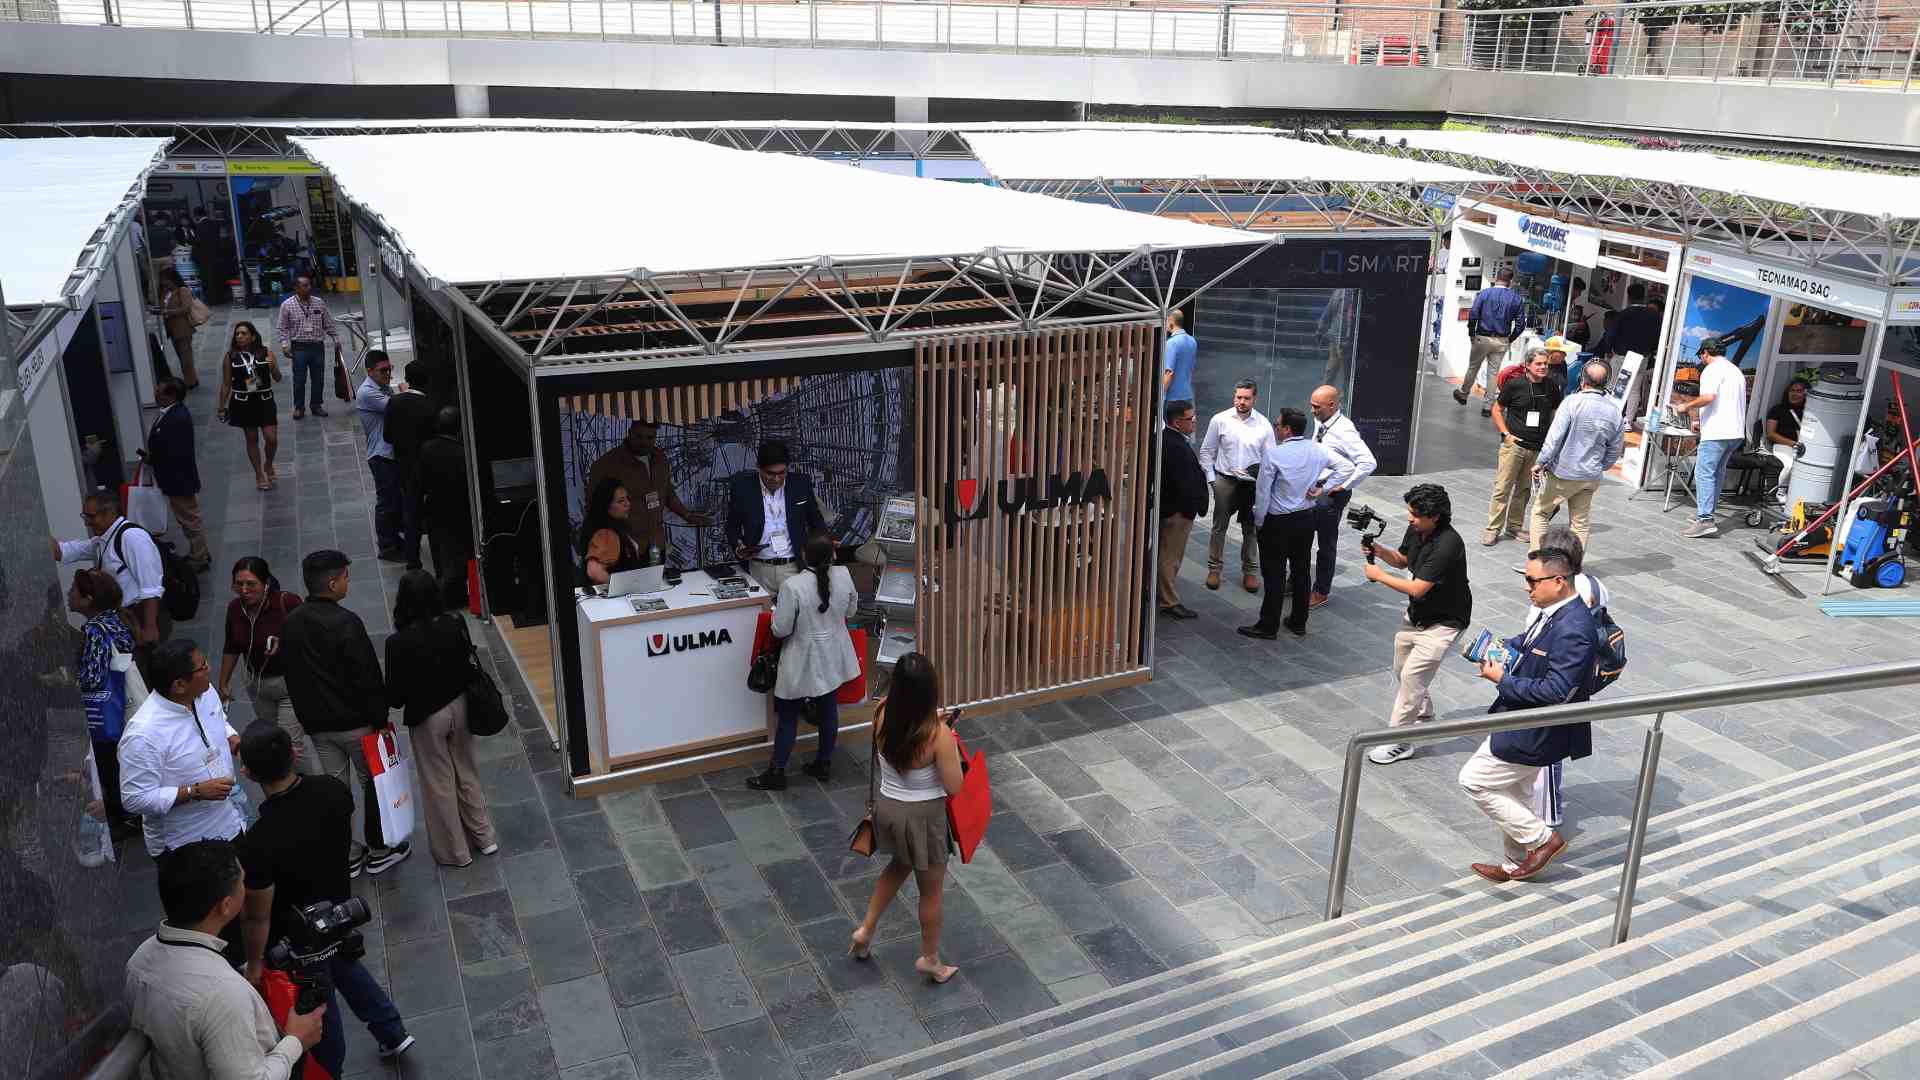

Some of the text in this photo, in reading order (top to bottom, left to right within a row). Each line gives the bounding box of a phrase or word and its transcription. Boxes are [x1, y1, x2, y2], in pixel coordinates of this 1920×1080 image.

[1347, 254, 1423, 273] SMART
[1757, 267, 1831, 298] TECNAMAQ SAC
[998, 468, 1112, 515] ULMA
[673, 628, 732, 652] ULMA
